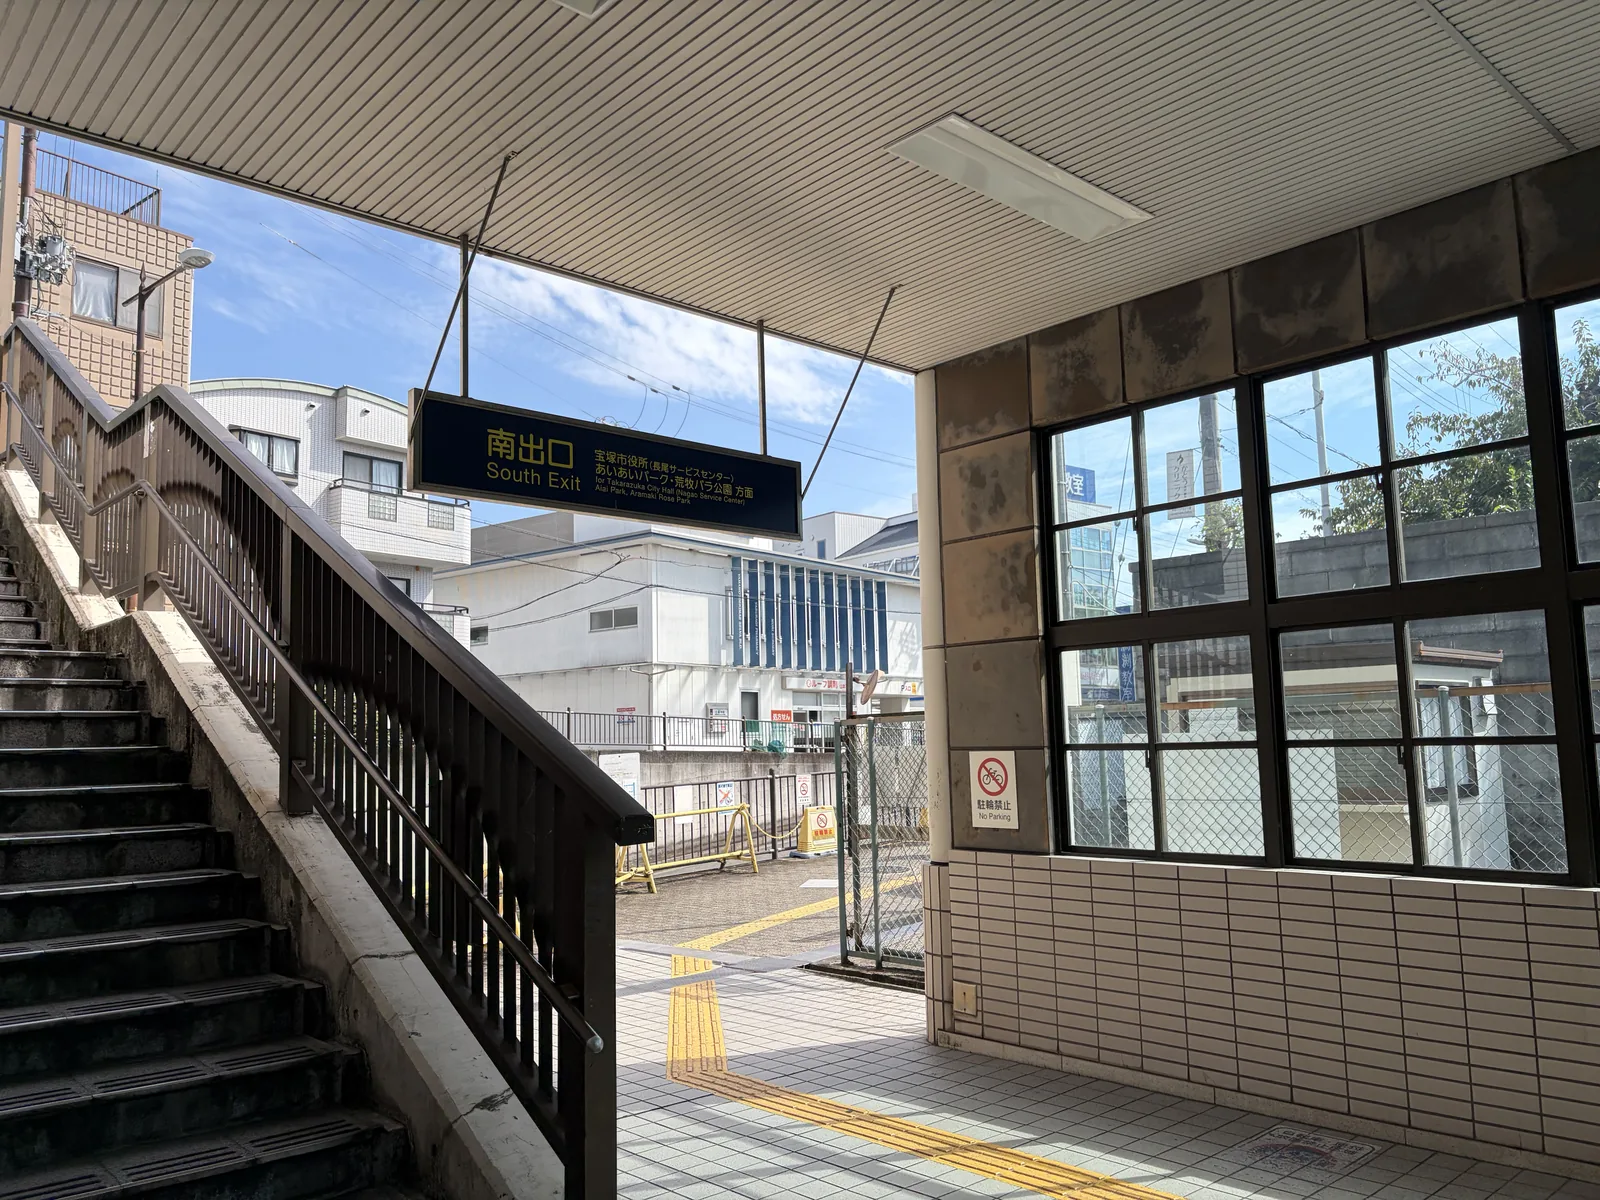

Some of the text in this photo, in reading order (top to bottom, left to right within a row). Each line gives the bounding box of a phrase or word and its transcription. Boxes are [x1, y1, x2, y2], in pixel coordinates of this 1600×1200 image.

[487, 428, 574, 469] 南出口
[487, 461, 581, 491] South Exit
[607, 477, 646, 491] Takarazuka
[647, 484, 660, 493] City
[662, 487, 675, 495] Hall
[700, 492, 722, 502] Service
[735, 486, 754, 499] 方面
[630, 490, 657, 500] Aramaki
[658, 494, 675, 503] Rose
[676, 496, 691, 505] Park
[977, 799, 1012, 810] 駐輪禁止
[978, 812, 1011, 822] No Parking
